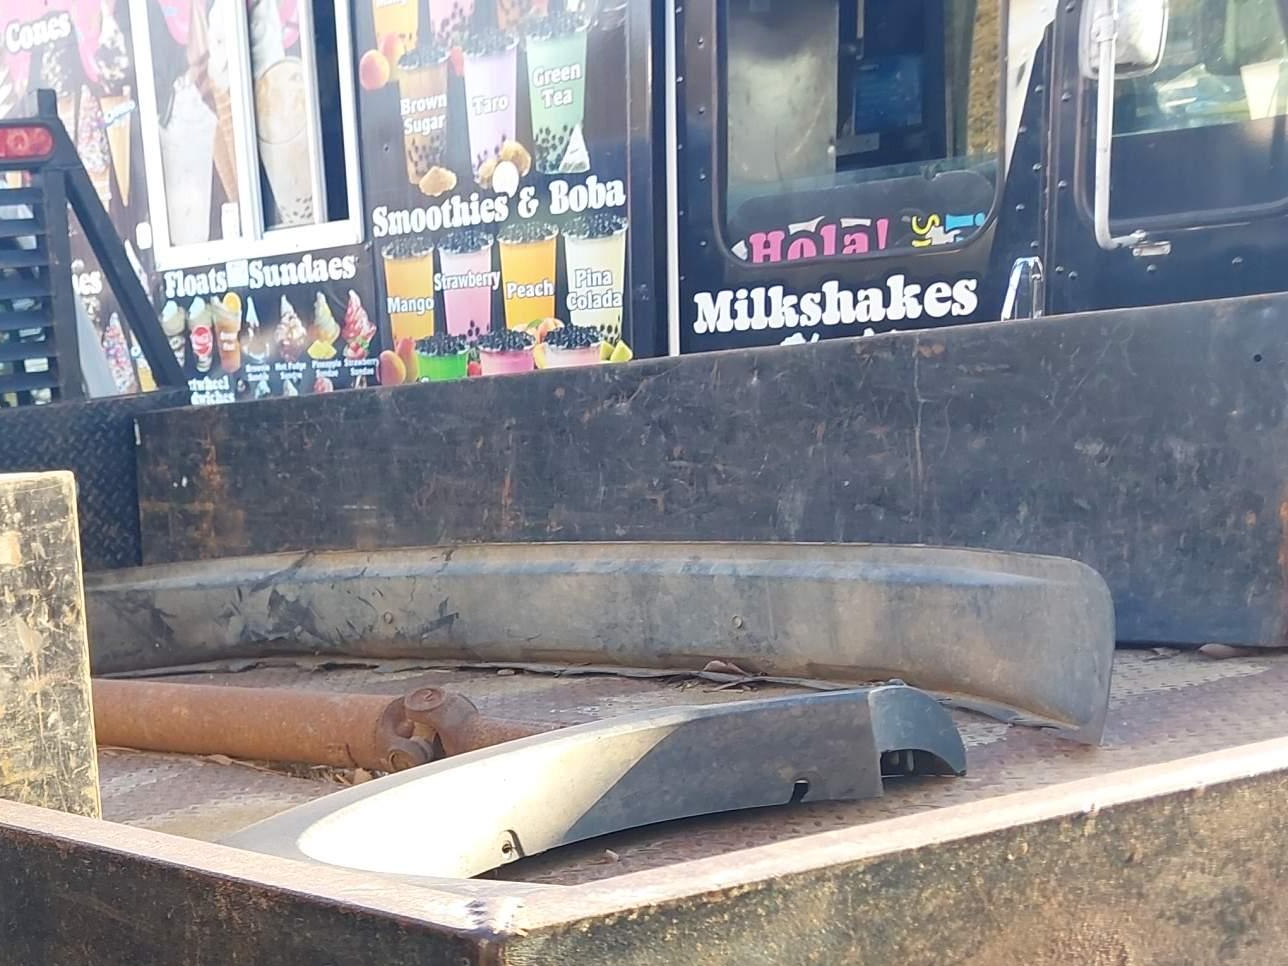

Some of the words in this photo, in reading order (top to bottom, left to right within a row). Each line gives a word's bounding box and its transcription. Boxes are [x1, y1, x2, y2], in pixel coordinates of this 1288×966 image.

[6, 13, 71, 52] Cones
[532, 62, 581, 87] Green
[400, 93, 447, 115] Brown
[472, 95, 508, 115] Taro
[543, 87, 572, 108] Tea
[404, 112, 445, 135] Sugar
[372, 193, 509, 237] Smoothies
[518, 186, 538, 218] &
[549, 175, 626, 214] Boba
[749, 218, 888, 263] Hola!
[164, 268, 227, 298] Floats
[248, 254, 357, 289] Sundaes
[434, 269, 500, 291] Strawberry
[575, 269, 611, 288] Pina
[507, 280, 554, 299] Peach
[566, 289, 623, 310] Colada
[387, 295, 434, 316] Mango
[693, 275, 978, 333] Milkshakes
